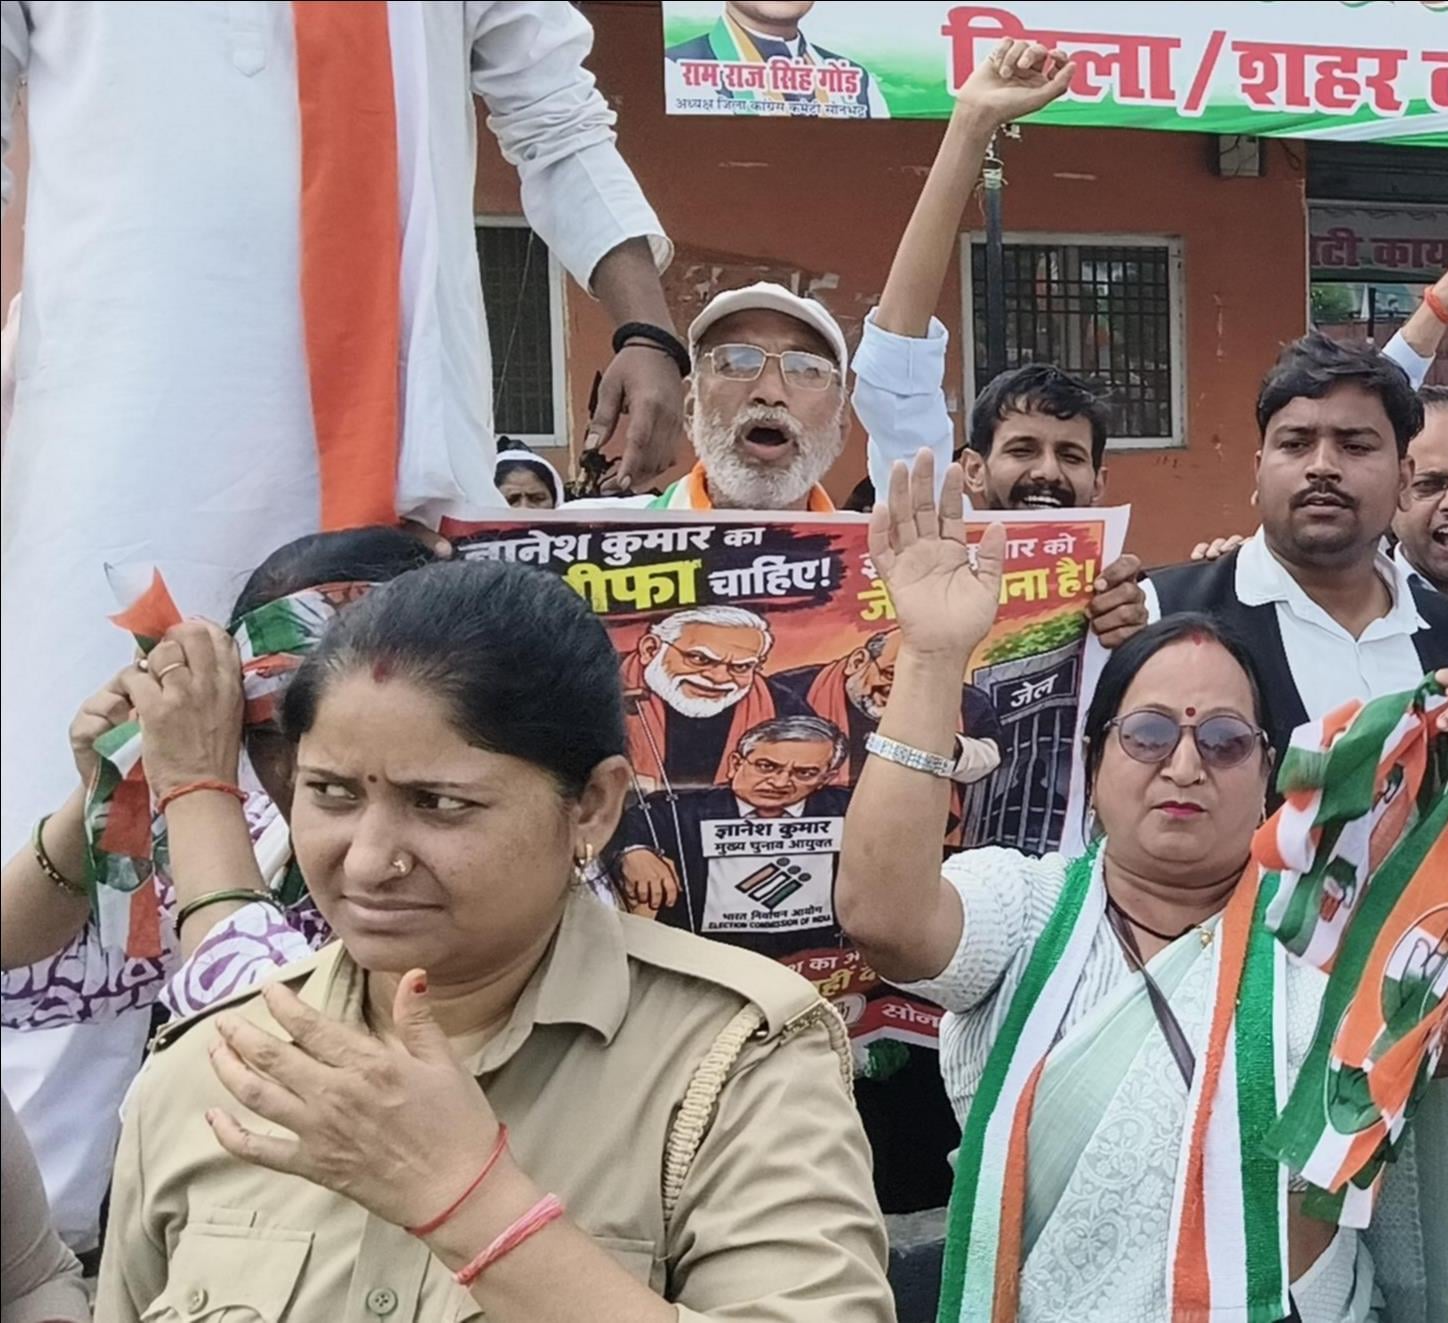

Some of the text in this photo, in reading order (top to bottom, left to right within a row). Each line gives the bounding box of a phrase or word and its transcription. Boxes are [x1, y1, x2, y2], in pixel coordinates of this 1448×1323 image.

[680, 62, 719, 87] राम
[724, 63, 766, 89] राज
[769, 58, 813, 92] सिंह
[601, 525, 716, 566] कुमार
[723, 527, 767, 548] का
[1042, 532, 1077, 556] को
[1010, 673, 1059, 709] जेल
[714, 819, 832, 840] ज्ञानेश कुमार
